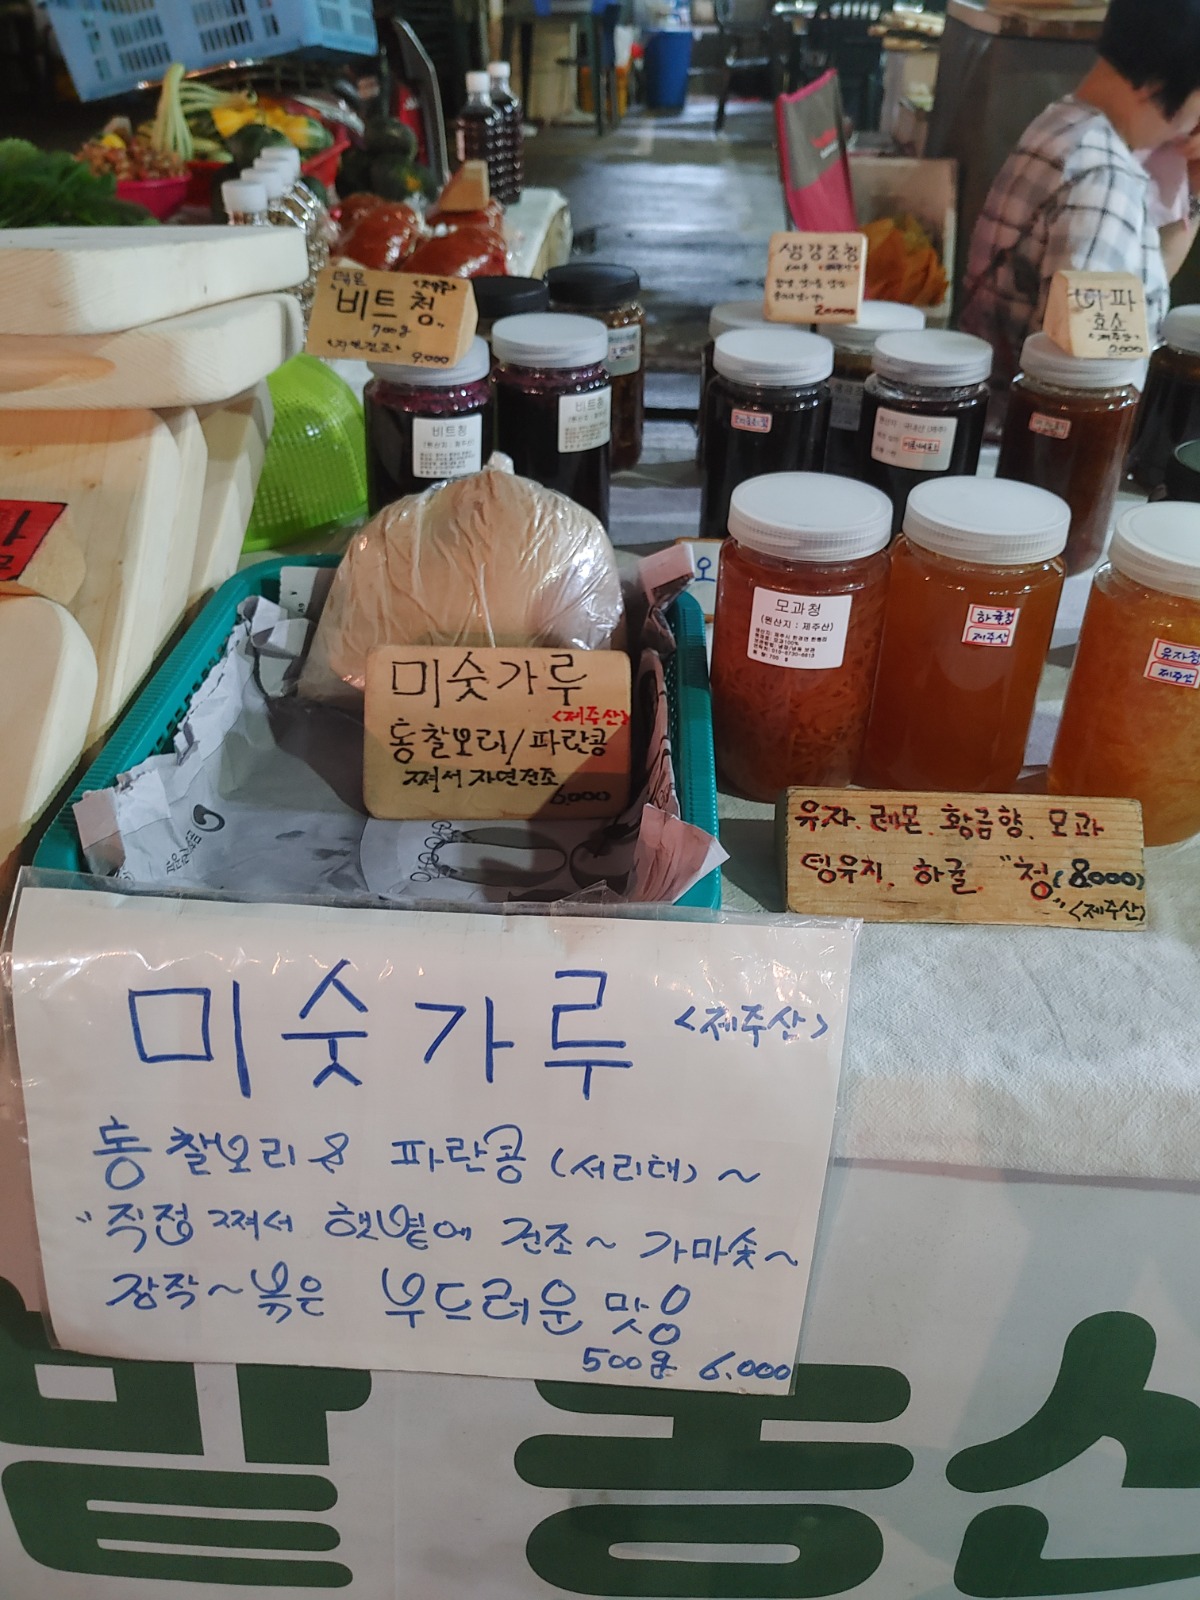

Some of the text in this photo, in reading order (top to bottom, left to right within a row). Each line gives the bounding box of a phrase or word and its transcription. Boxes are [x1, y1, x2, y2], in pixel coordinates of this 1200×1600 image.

[779, 242, 858, 262] 생강조청
[1092, 311, 1127, 332] 효소
[575, 396, 603, 412] 비트청
[432, 424, 467, 437] 비트청
[775, 598, 821, 617] 모과청
[760, 614, 792, 629] (원산지
[802, 621, 834, 632] 제주산)
[972, 631, 1008, 644] 제주산
[1161, 647, 1200, 665] 유자청
[391, 651, 588, 708] 미숫가루
[1158, 668, 1195, 684] 제주산
[552, 706, 630, 727] <제주산>
[402, 766, 463, 793] 쪄서
[1048, 807, 1105, 838] 모과
[1068, 899, 1146, 922] <제주산>
[128, 958, 830, 1102] 미숫가루 <제주산>
[391, 1123, 527, 1185] 파란콩
[549, 1147, 698, 1184] (서리태)
[206, 1209, 294, 1242] 쪄서
[380, 1266, 585, 1335] 부드러운
[698, 1350, 792, 1381] 6.000
